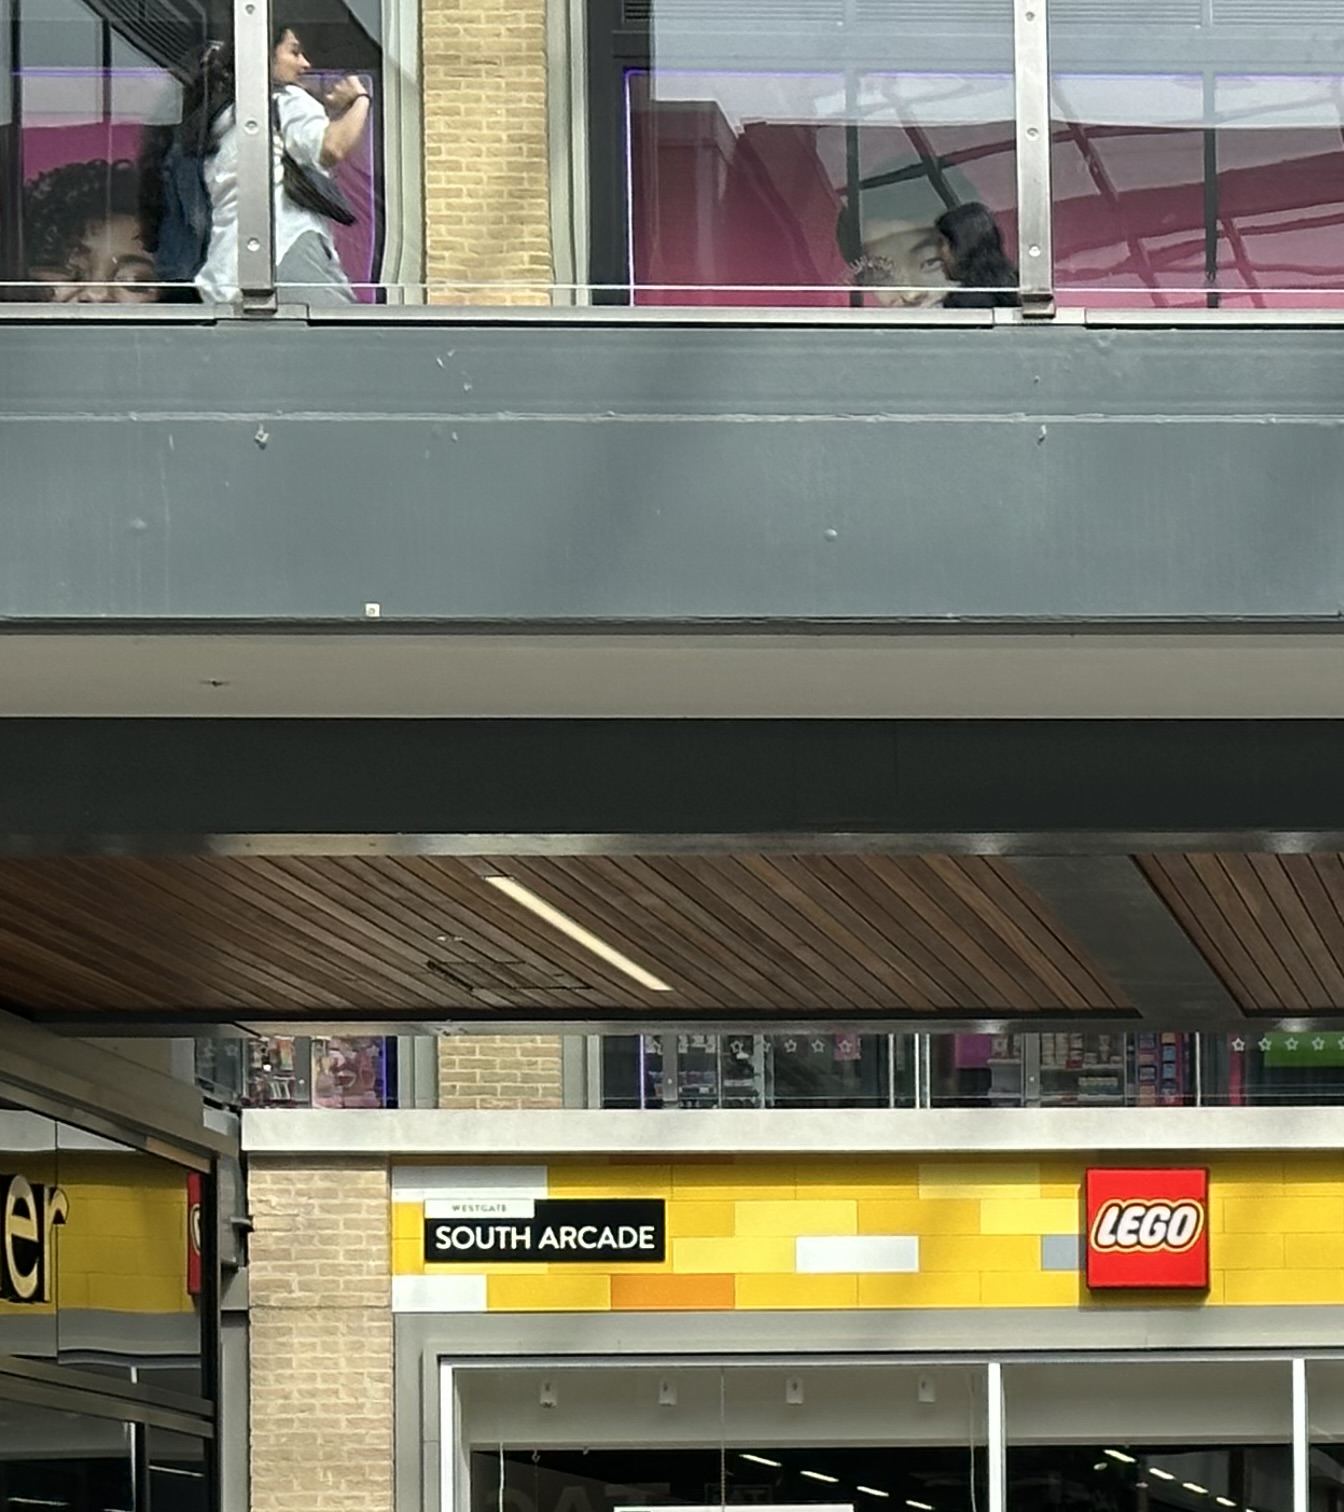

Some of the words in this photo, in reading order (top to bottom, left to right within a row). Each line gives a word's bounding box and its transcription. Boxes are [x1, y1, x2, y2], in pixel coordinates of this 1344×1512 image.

[452, 1204, 507, 1213] WESTGATE
[435, 1226, 531, 1250] SOUTH
[538, 1226, 655, 1250] ARCADE
[1094, 1203, 1201, 1249] LEGO
